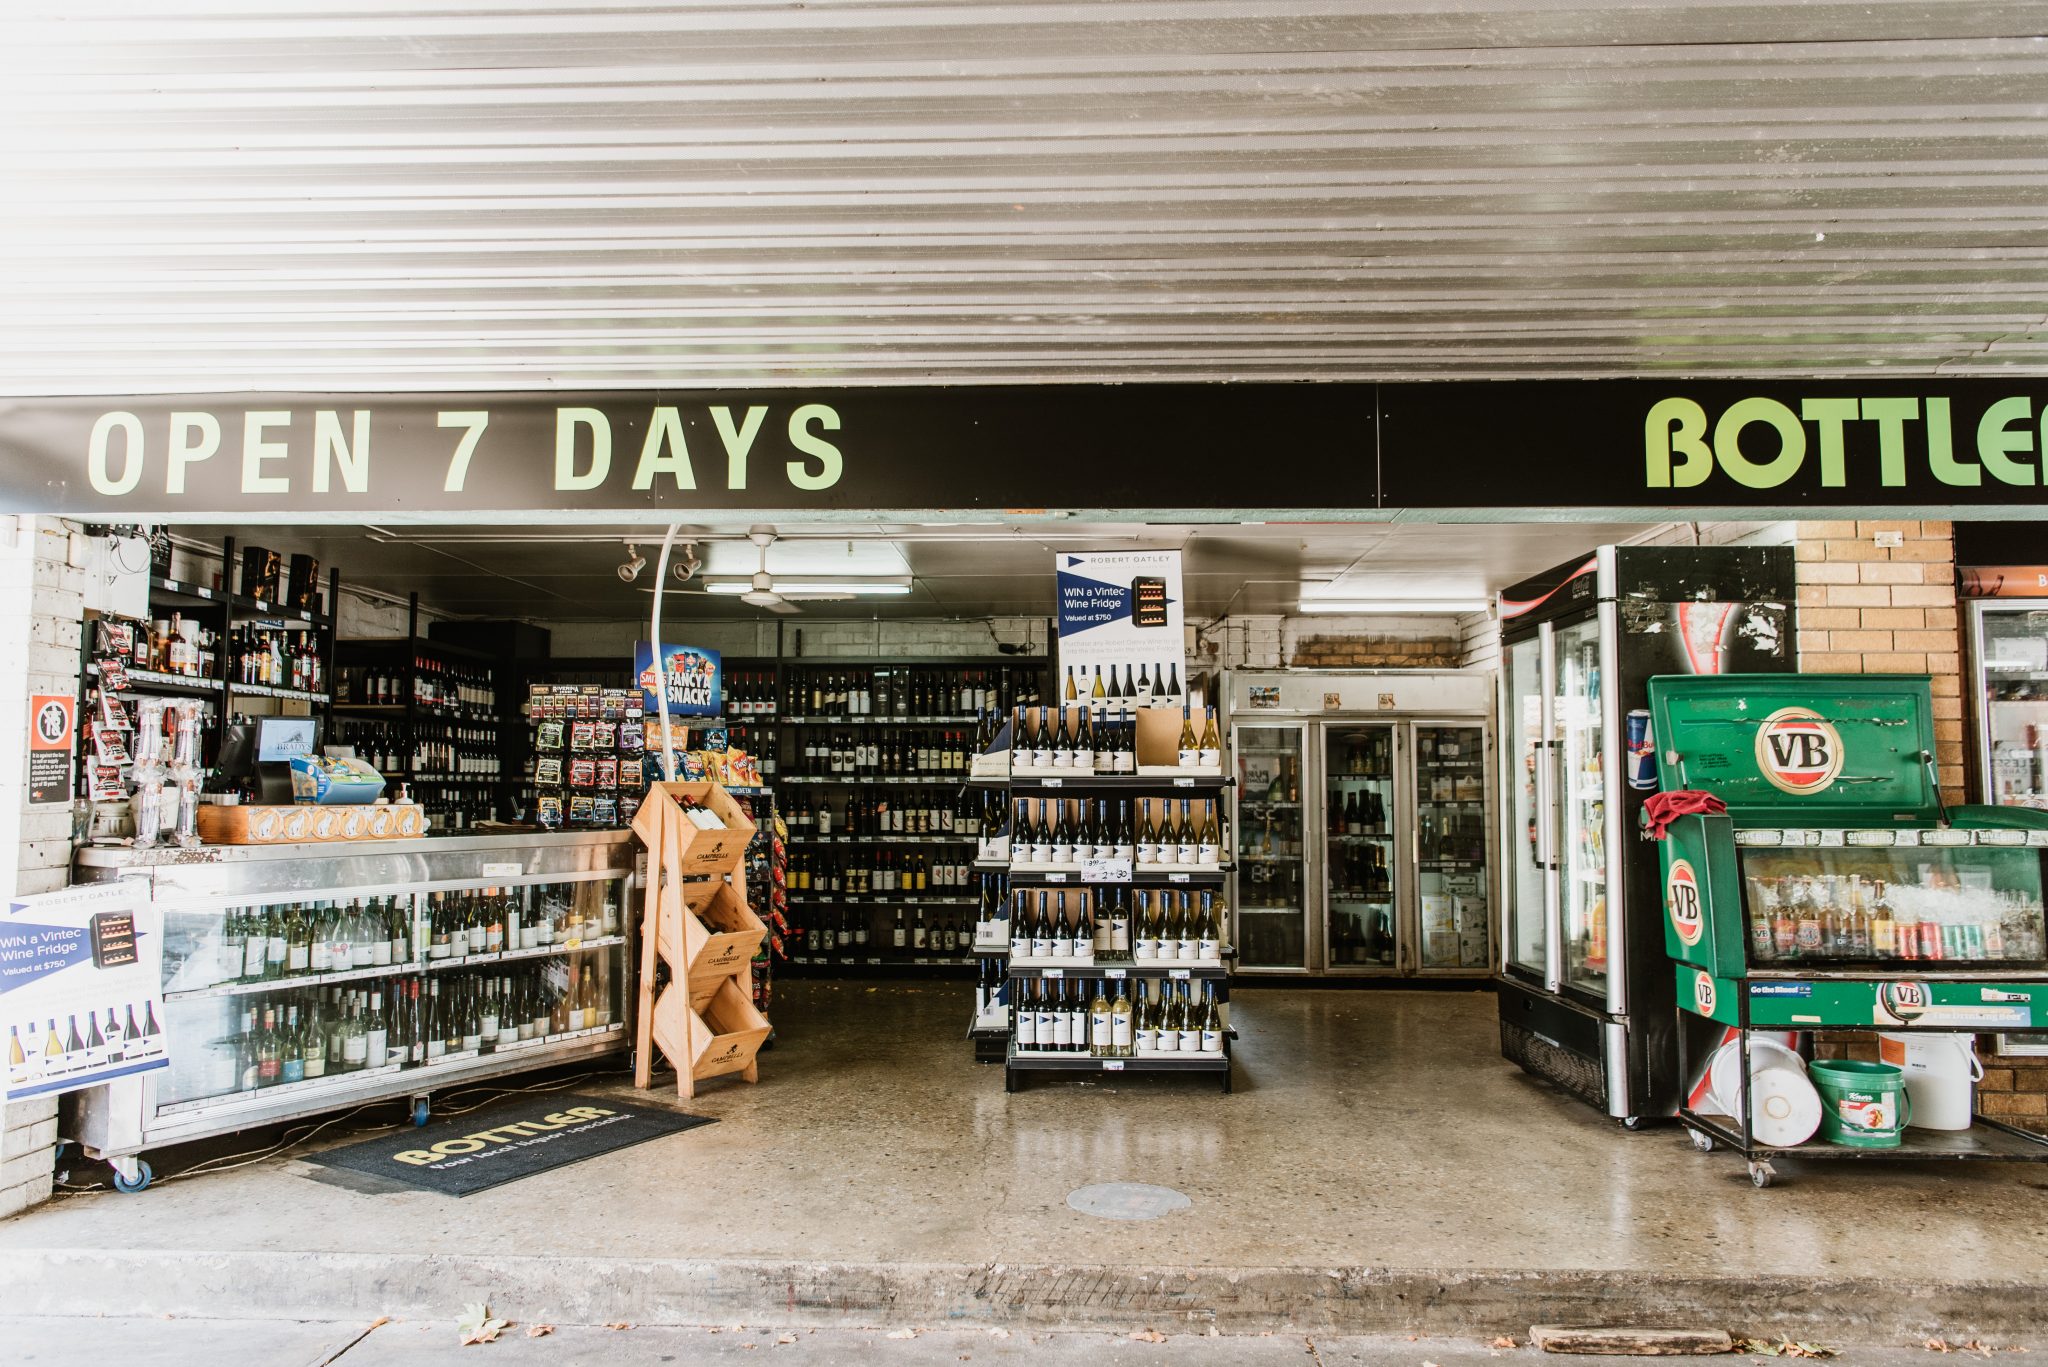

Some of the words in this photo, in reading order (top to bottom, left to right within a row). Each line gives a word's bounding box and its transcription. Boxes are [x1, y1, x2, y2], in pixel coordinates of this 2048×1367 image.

[87, 409, 371, 496] OPEN
[437, 410, 489, 492] 7
[554, 404, 844, 490] DAYS
[1645, 396, 2048, 489] BOTTLE
[1090, 556, 1130, 564] ROBERT
[1133, 555, 1170, 563] OATLEY
[1064, 587, 1084, 597] WIN
[1086, 589, 1093, 597] a
[1094, 587, 1125, 597] Vintec
[1064, 599, 1089, 609] Wine
[1091, 598, 1122, 610] Fridge
[1064, 614, 1086, 622] Valued
[1095, 613, 1111, 621] $750
[668, 672, 703, 688] FANCY
[668, 688, 712, 706] SNACK?
[1628, 739, 1641, 748] Red
[1643, 740, 1655, 748] Bu
[1767, 733, 1829, 768] VB
[697, 852, 729, 860] CAMPBELLS
[37, 895, 84, 908] ROBERT
[1672, 883, 1698, 920] VB
[0, 935, 27, 949] WIN
[30, 935, 38, 945] a
[40, 928, 81, 943] Vintec
[1, 947, 34, 962] Wine
[38, 942, 78, 957] Fridge
[2, 965, 33, 977] Valued
[34, 964, 42, 973] at
[43, 959, 66, 971] $750
[1698, 985, 1712, 1006] VB
[1750, 986, 1761, 994] Go
[1761, 986, 1774, 994] the
[1896, 986, 1920, 1004] VB
[1848, 1092, 1874, 1101] Knorr
[392, 1106, 617, 1166] BOTTLER
[473, 1144, 516, 1159] local
[516, 1131, 566, 1147] liquor
[566, 1113, 635, 1134] specialist
